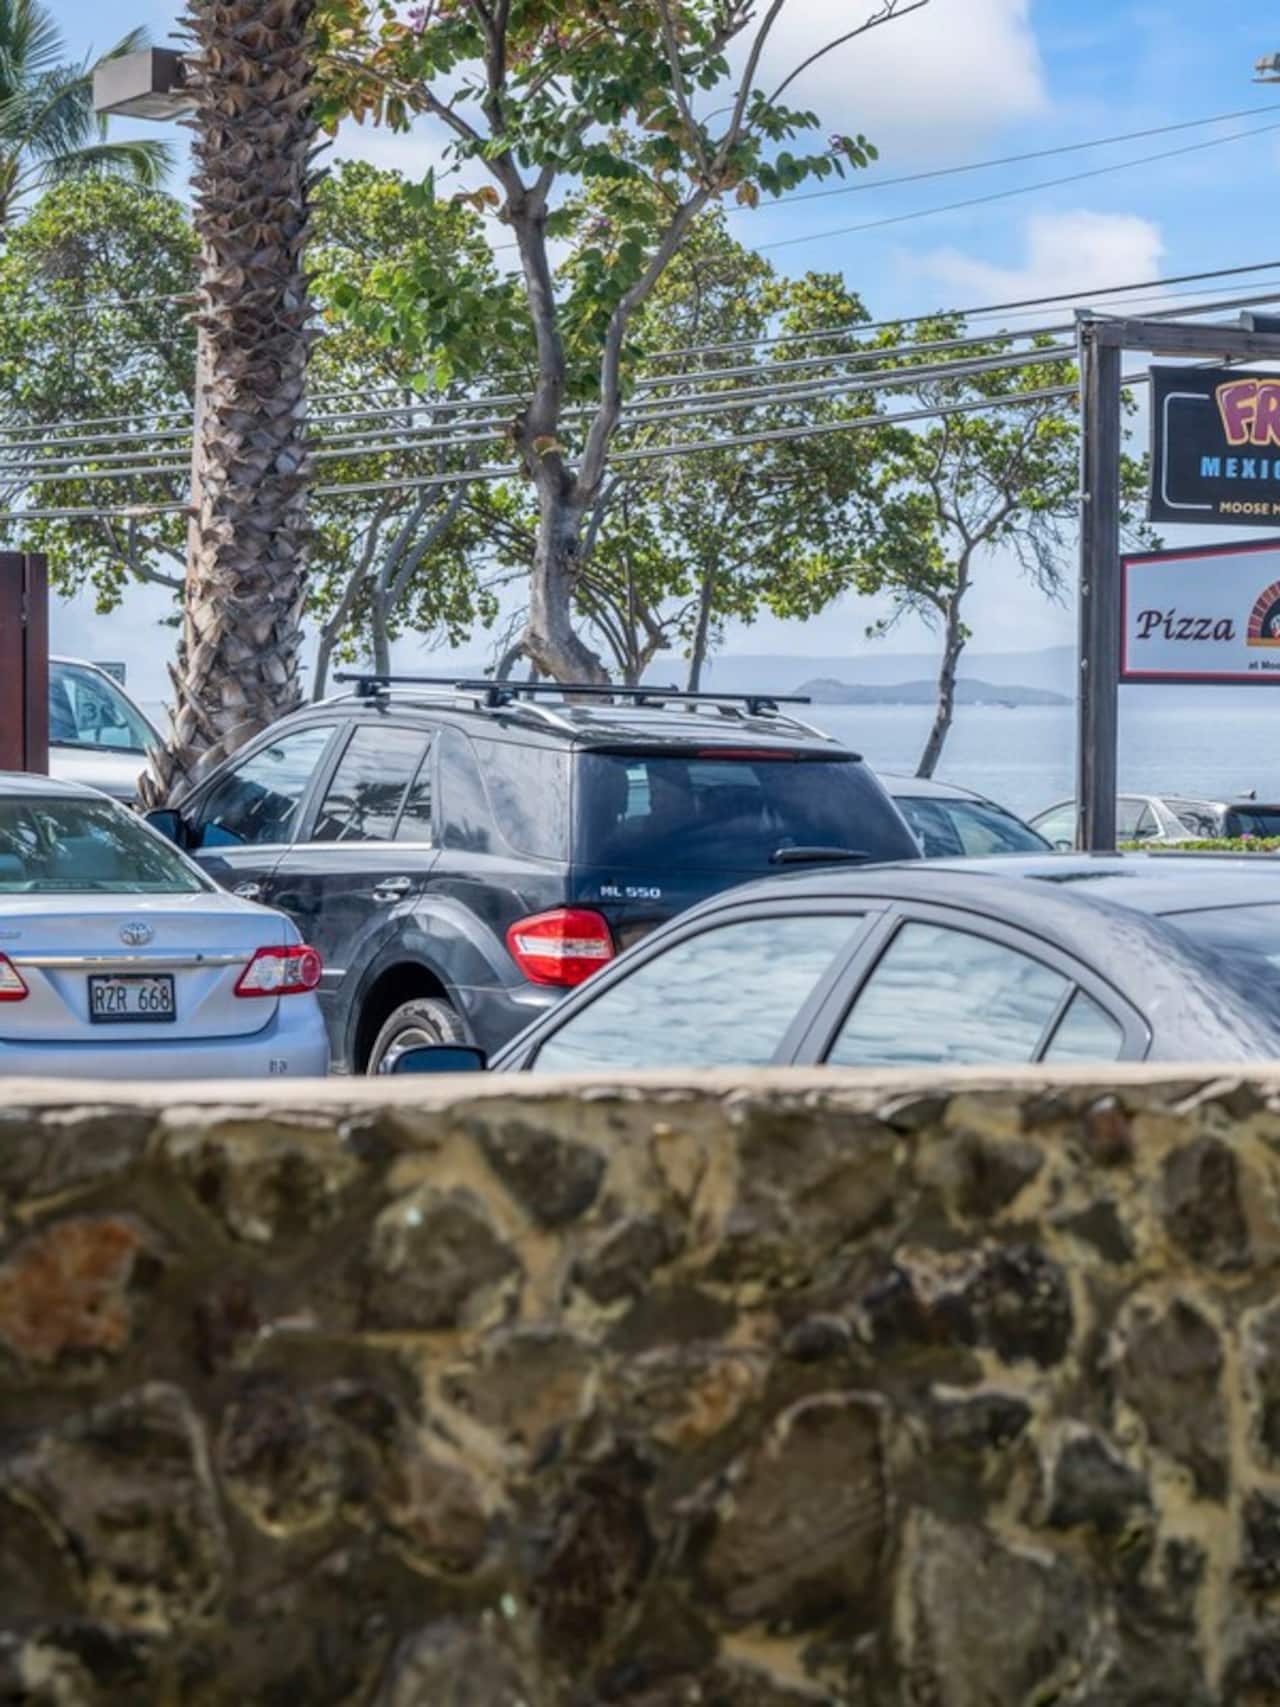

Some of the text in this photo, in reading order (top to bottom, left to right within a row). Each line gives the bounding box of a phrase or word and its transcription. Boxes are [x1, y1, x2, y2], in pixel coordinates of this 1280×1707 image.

[1219, 502, 1269, 515] MOOSE
[1136, 609, 1235, 641] Pizza
[1248, 661, 1258, 670] at
[600, 886, 661, 898] ML 550
[95, 985, 170, 1011] RZR 668
